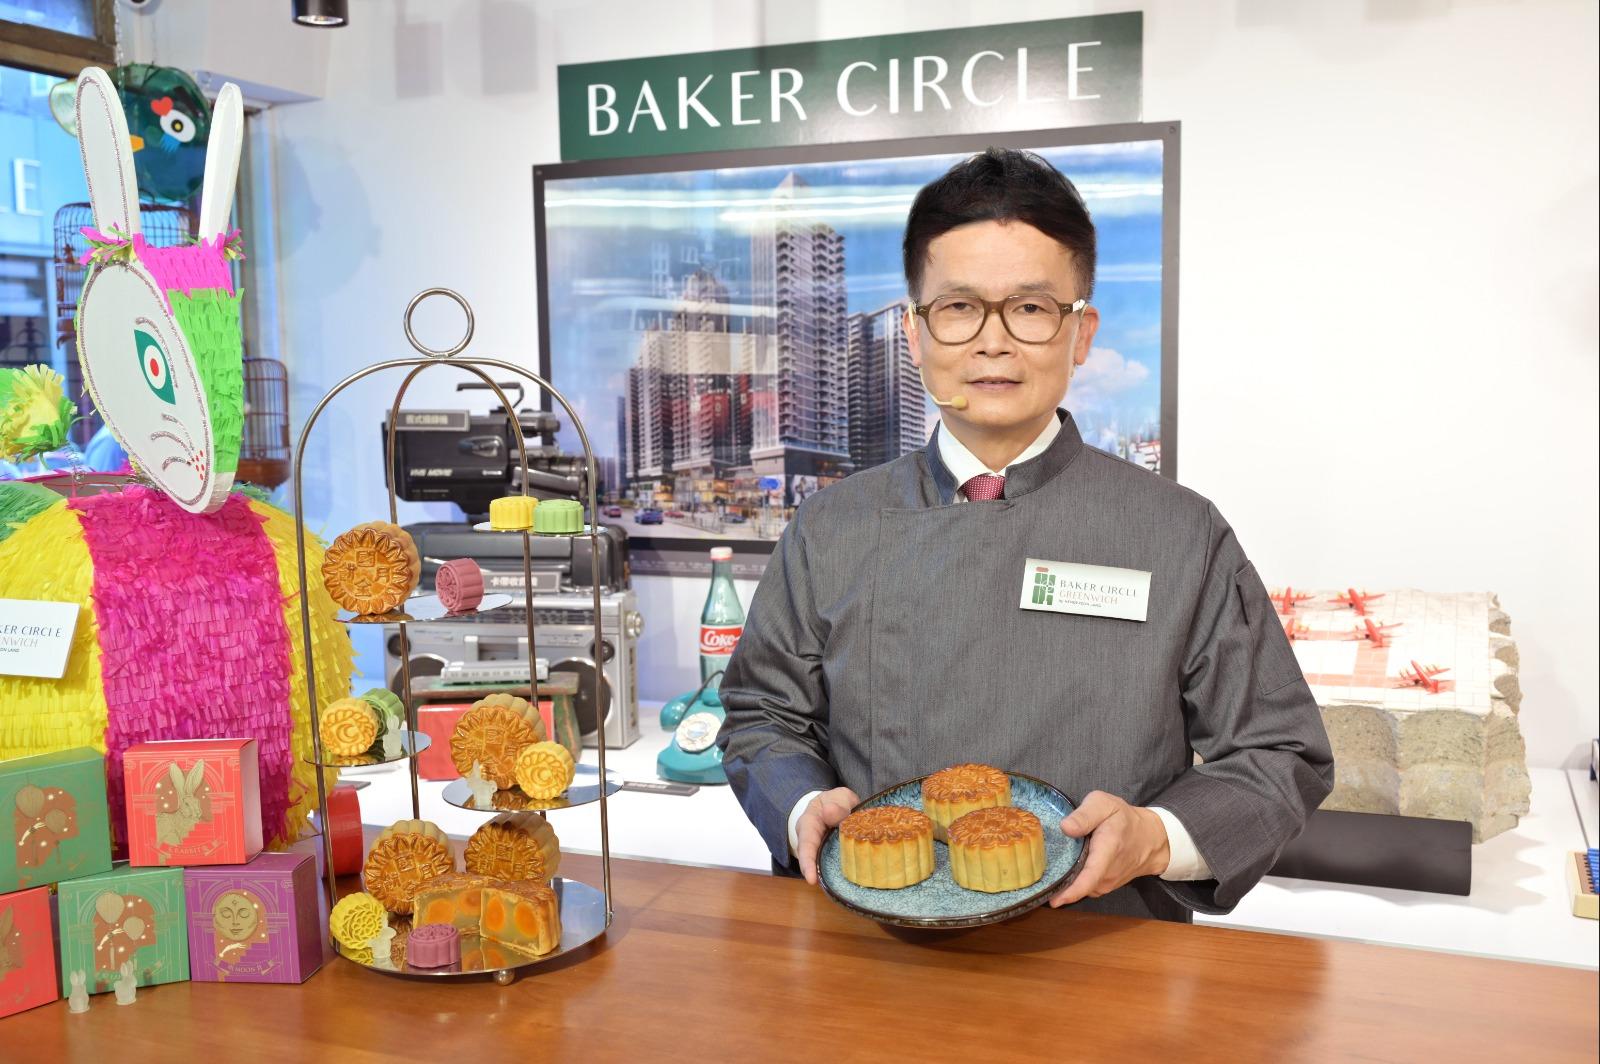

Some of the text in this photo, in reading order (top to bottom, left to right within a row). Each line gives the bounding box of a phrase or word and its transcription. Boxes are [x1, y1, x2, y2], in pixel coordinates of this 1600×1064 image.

[587, 40, 1103, 137] BAKER CIRCLE
[1060, 579, 1096, 592] BAKER
[1059, 590, 1118, 605] GREENWICH
[21, 625, 62, 637] CIRCLE
[704, 630, 736, 647] Coke
